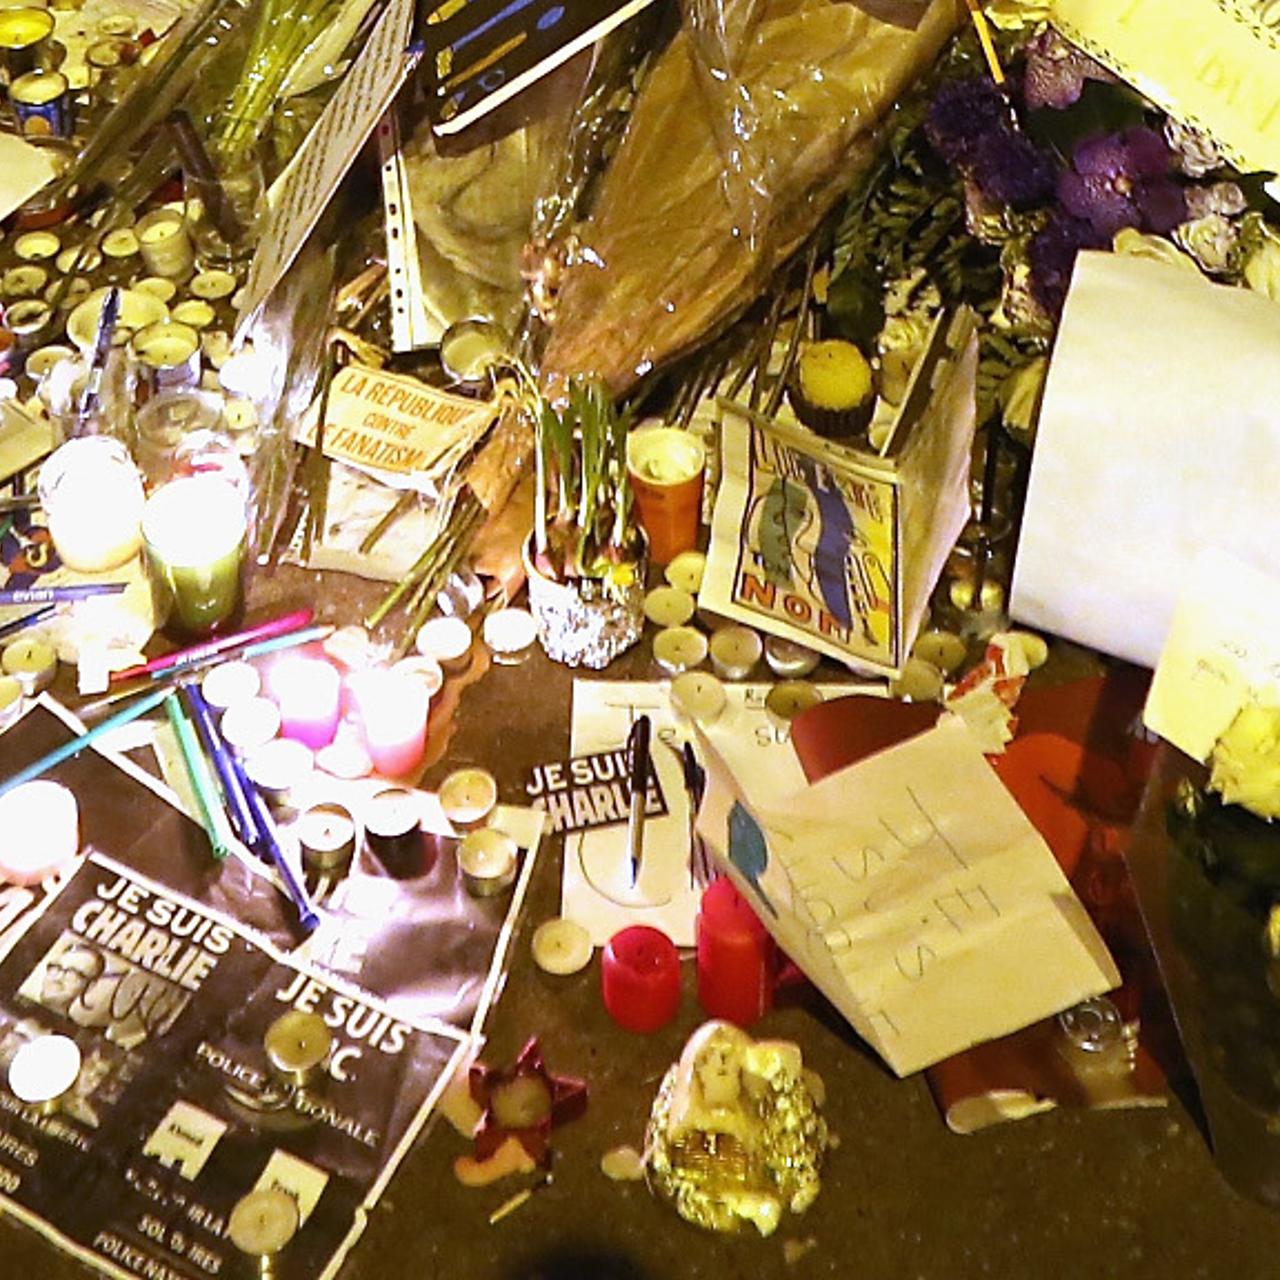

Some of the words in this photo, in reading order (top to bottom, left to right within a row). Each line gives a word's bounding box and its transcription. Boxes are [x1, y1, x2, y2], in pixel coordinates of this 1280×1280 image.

[340, 374, 368, 400] LA
[363, 413, 417, 439] CONTRE
[526, 763, 567, 795] JE
[570, 749, 634, 786] SUI
[97, 877, 142, 915] JE
[145, 894, 235, 955] SUIS
[72, 900, 218, 991] CHARLIE
[276, 973, 328, 1014] JE
[324, 997, 413, 1054] SUIS
[196, 1042, 265, 1086] POLICE
